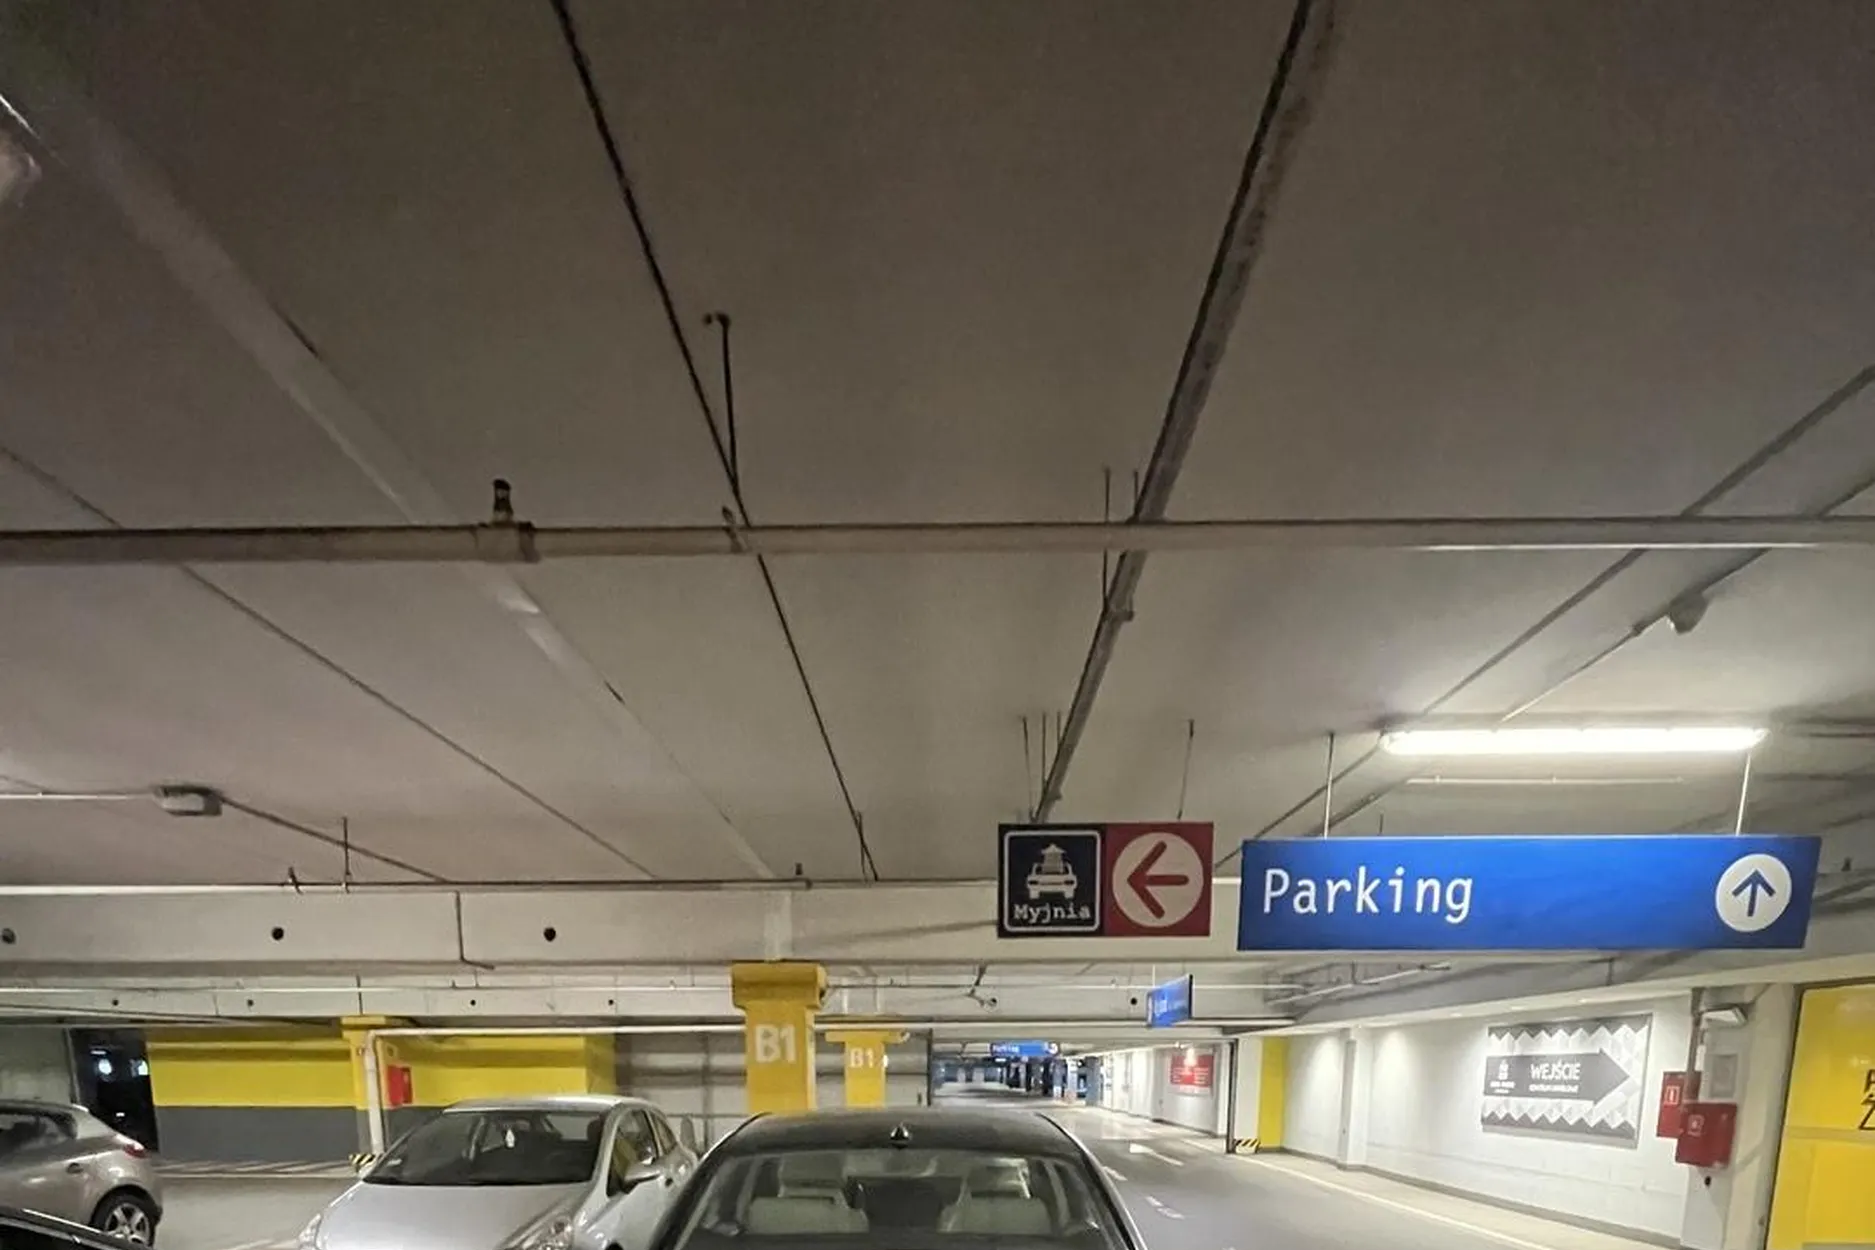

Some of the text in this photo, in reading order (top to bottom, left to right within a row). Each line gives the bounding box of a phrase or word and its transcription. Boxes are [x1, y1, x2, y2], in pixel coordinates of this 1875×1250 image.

[1263, 865, 1473, 924] Parking
[1012, 902, 1092, 924] Myjnia
[755, 1024, 797, 1063] B1
[849, 1048, 874, 1069] B1
[1529, 1059, 1582, 1081] WEJŚCIE
